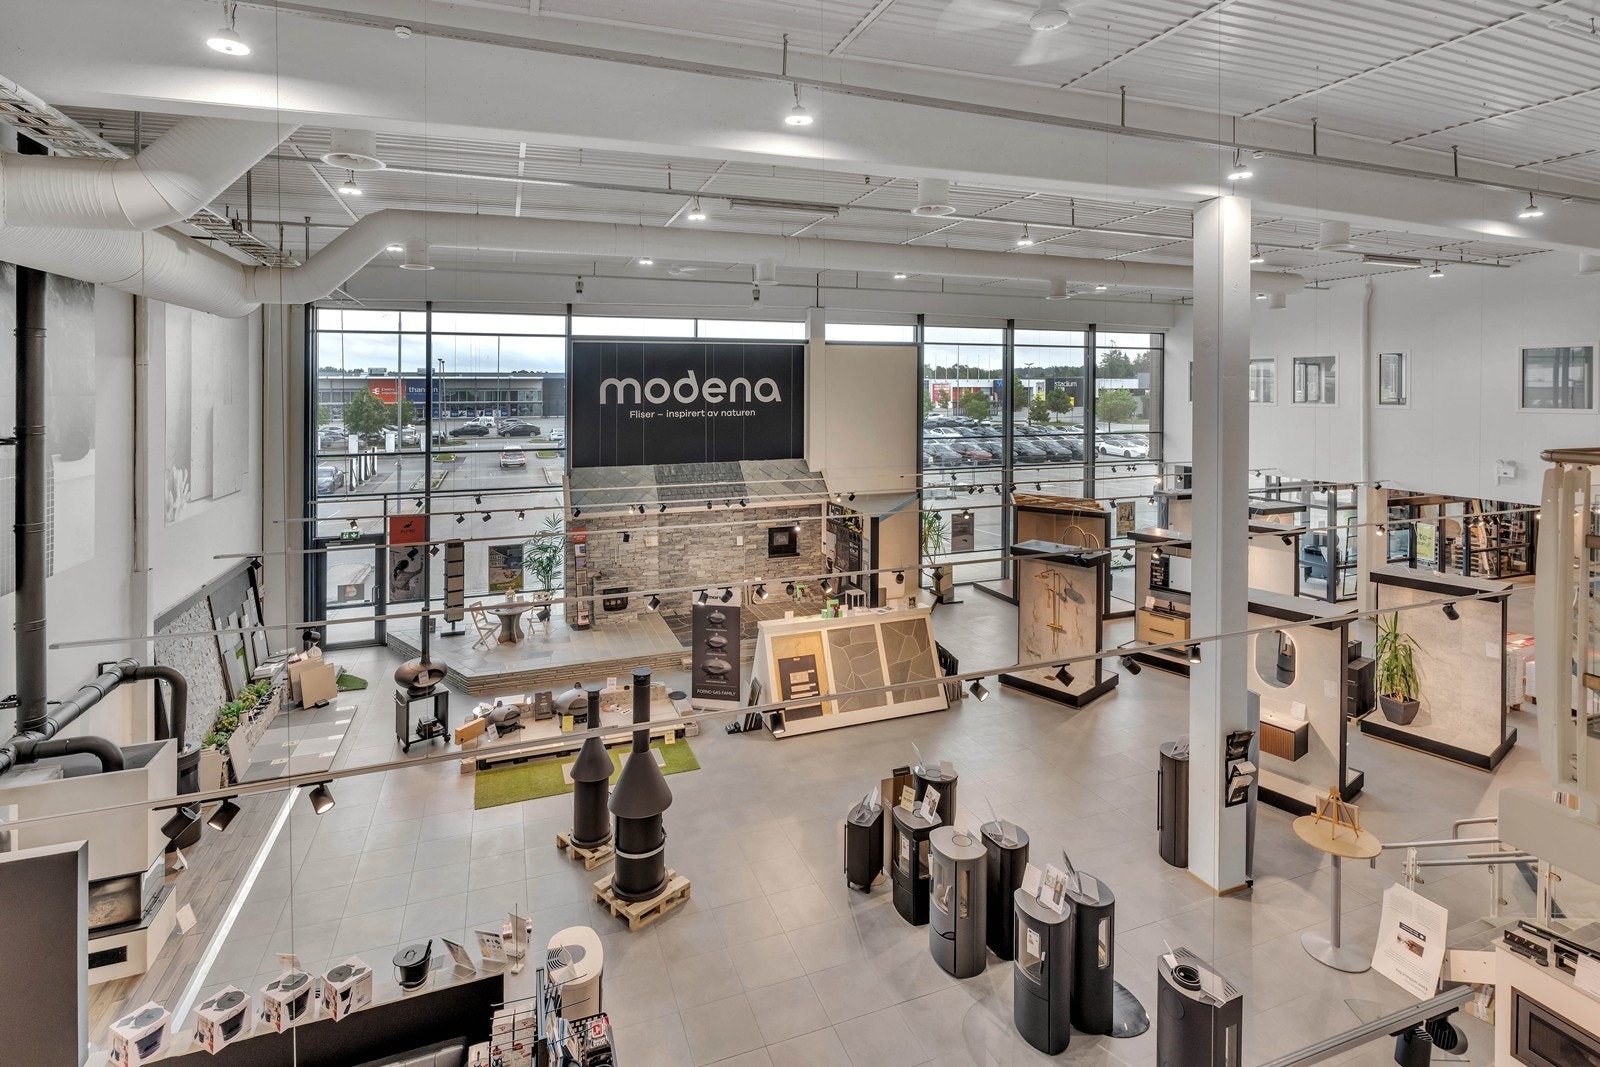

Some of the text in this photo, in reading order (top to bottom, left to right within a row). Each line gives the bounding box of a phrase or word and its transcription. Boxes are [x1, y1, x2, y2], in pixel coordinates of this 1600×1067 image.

[600, 370, 782, 405] modena
[629, 410, 655, 419] Fliser
[666, 409, 705, 419] inspirert
[707, 410, 718, 418] av
[720, 409, 756, 417] naturen
